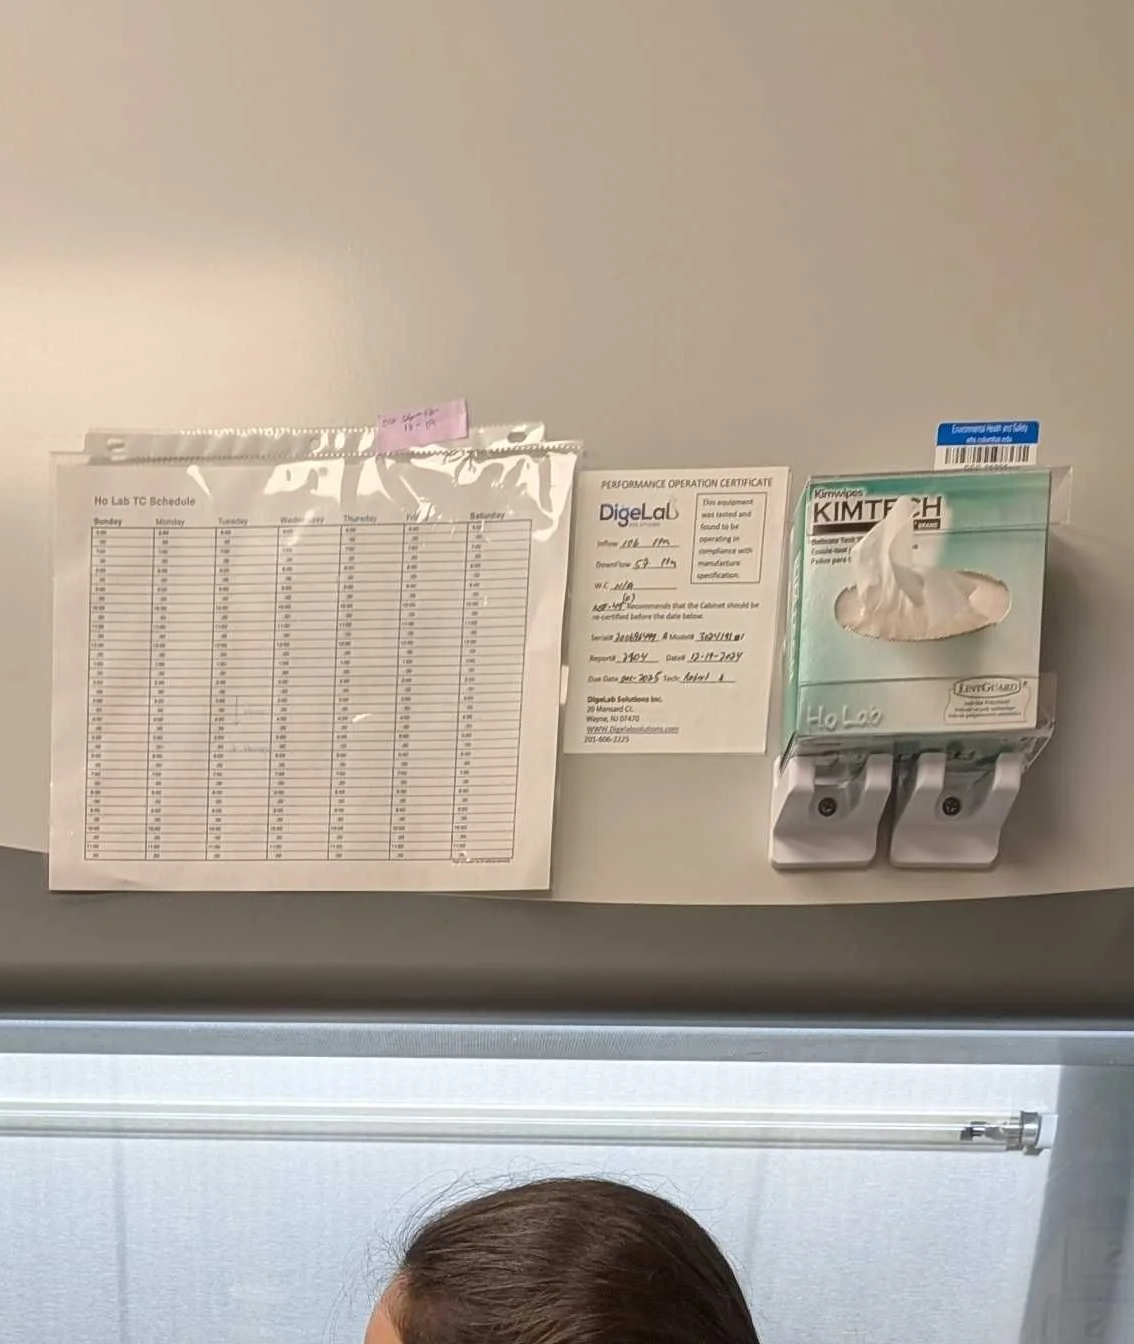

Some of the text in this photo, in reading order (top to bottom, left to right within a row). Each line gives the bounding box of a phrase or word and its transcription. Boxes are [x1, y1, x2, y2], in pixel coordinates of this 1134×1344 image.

[986, 424, 1002, 433] Health
[1013, 422, 1028, 432] Safety
[601, 478, 772, 489] PERFORMANCE OPERATION CERTIFICATE
[814, 488, 863, 498] Kimwipes
[94, 496, 196, 506] Ho Lab TC Schedule
[717, 499, 753, 507] equipment
[812, 496, 942, 522] KIMTEH
[344, 514, 377, 523] Thursday
[470, 512, 505, 521] Saturday
[94, 517, 122, 527] Sunday
[155, 518, 185, 527] Monday
[218, 518, 248, 526] Tuesday
[730, 522, 739, 530] be
[699, 536, 731, 544] operating
[653, 612, 665, 620] the
[666, 612, 681, 620] date
[587, 695, 616, 704] DigeLab
[617, 695, 649, 703] Solutions
